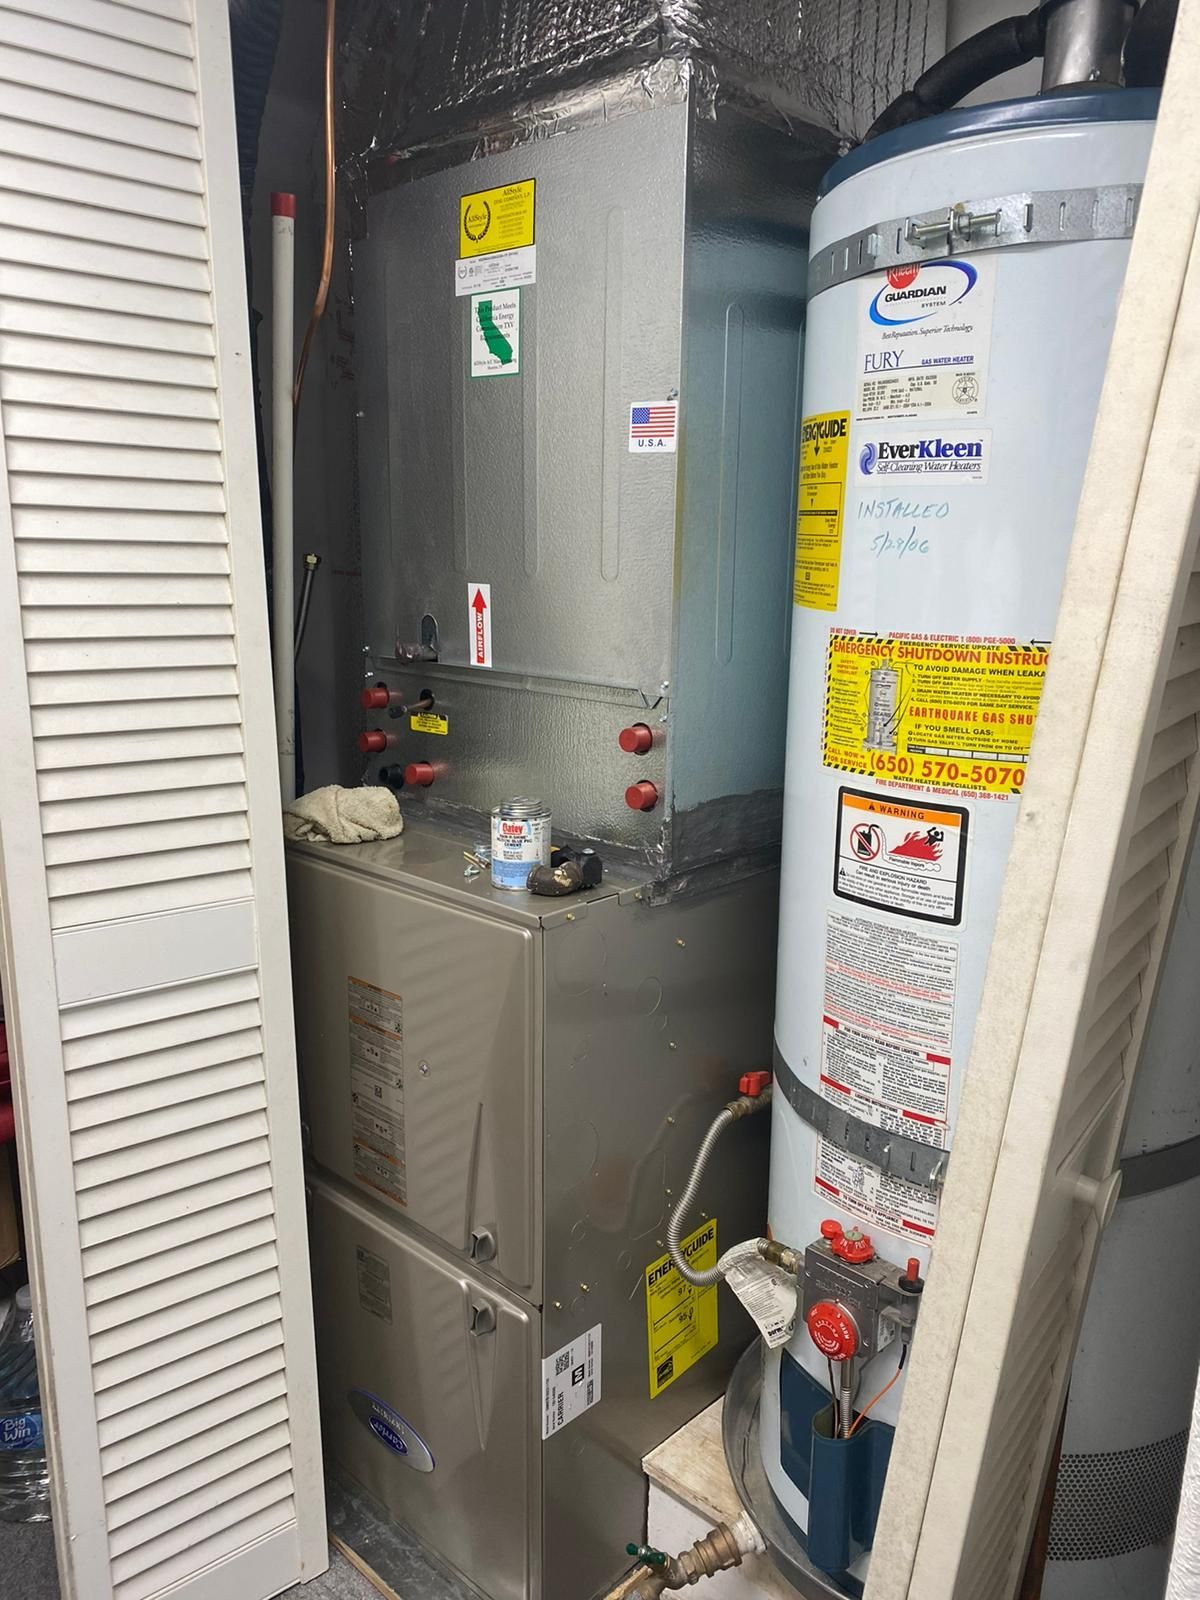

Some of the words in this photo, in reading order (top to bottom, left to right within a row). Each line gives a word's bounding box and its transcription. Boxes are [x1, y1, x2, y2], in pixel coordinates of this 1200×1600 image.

[885, 286, 946, 303] GUARDIAN
[921, 300, 946, 308] SYSTEM
[919, 325, 942, 337] Superior
[943, 323, 973, 333] Technology
[864, 350, 904, 371] FURY
[952, 355, 974, 363] HEATER
[638, 437, 667, 448] U.S.A.
[878, 438, 982, 459] EverKleen
[877, 462, 922, 473] Self-Cleaning
[924, 461, 948, 471] Water
[949, 461, 981, 471] Heaters
[857, 497, 949, 520] INSTALLED
[889, 632, 910, 641] PACIFIC
[910, 633, 923, 641] GAS
[930, 634, 960, 643] ELECTRIC
[983, 636, 1016, 645] PGE-5000
[899, 640, 938, 649] EMERGENCY
[940, 642, 971, 650] SERVICE
[833, 641, 894, 657] EMERGENCY
[898, 648, 981, 664] SHUTDOWN
[925, 664, 949, 673] AVOID
[952, 666, 987, 676] DAMAGE
[909, 706, 978, 722] EARTHQUAKE
[982, 712, 1005, 724] GAS
[1009, 713, 1037, 725] SHU
[924, 724, 941, 732] YOU
[943, 726, 971, 735] SMELL
[973, 728, 994, 736] GAS:
[827, 746, 841, 755] CALL
[844, 750, 859, 759] NOW
[827, 754, 839, 763] FOR
[840, 757, 867, 769] SERVICE
[870, 753, 915, 776] (650)
[921, 760, 1025, 787] 570-5070
[875, 778, 887, 786] FIRE
[888, 779, 925, 792] DEPARTMENT
[931, 786, 960, 796] MEDICAL
[961, 789, 978, 799] (650)
[893, 775, 914, 783] WATER
[914, 777, 941, 786] HEATER
[942, 780, 987, 791] SPECIALISTS
[879, 804, 925, 820] WARNING
[502, 822, 524, 834] Oatey
[863, 871, 876, 880] result
[880, 876, 897, 885] serious
[897, 880, 911, 888] injury
[869, 867, 879, 875] AND
[879, 869, 906, 881] EXPLOSION
[906, 876, 928, 885] HAZARD
[861, 1033, 875, 1042] SAFETY
[885, 1043, 900, 1051] BEFORE
[648, 1228, 714, 1286] ENERYGUIDE
[574, 1366, 584, 1384] M
[557, 1391, 565, 1426] CARRIER
[3, 1418, 26, 1430] Big
[3, 1428, 31, 1441] Win
[373, 1421, 405, 1450] Carrier
